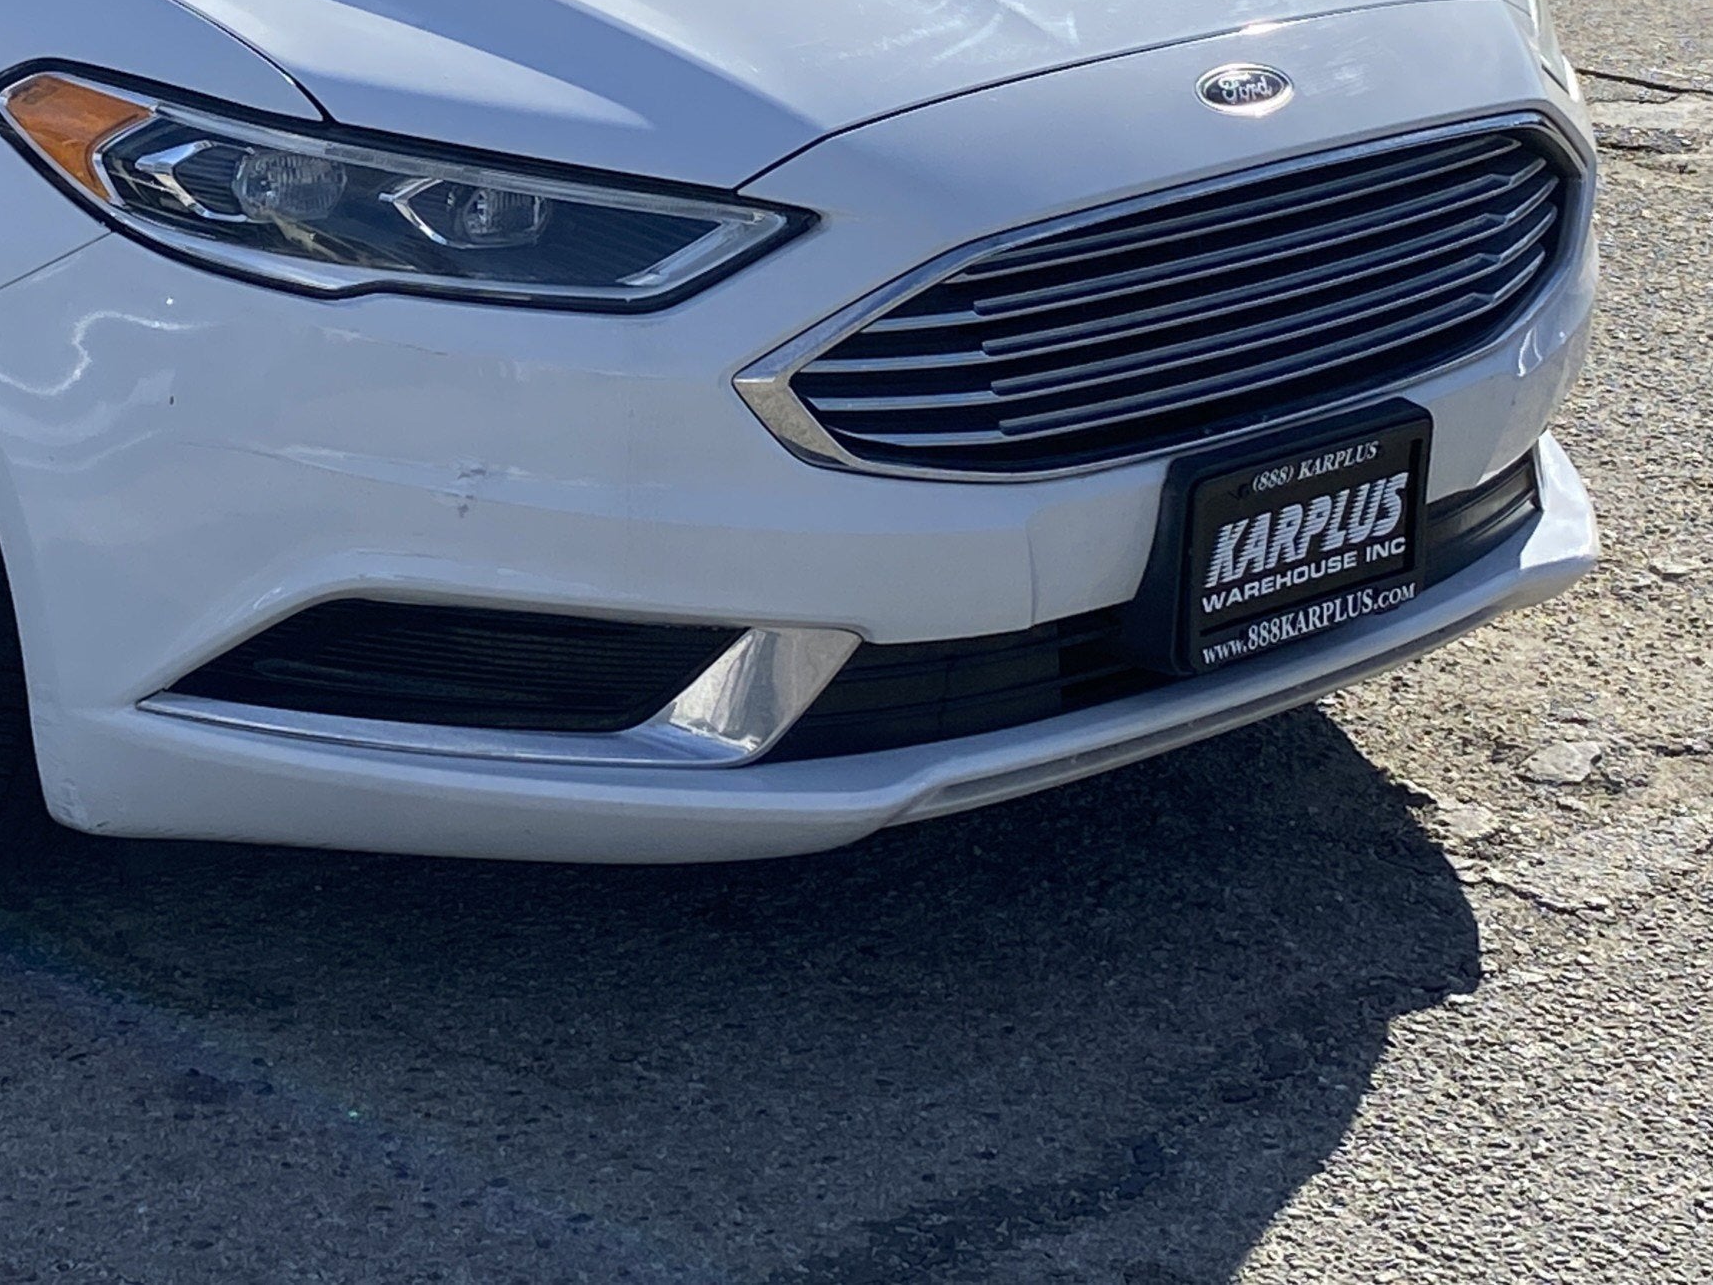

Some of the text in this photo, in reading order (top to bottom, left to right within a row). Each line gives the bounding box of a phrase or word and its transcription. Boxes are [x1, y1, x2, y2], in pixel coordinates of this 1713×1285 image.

[1217, 72, 1273, 105] Ford
[1252, 440, 1379, 493] (888) KARPLUS
[1204, 471, 1409, 589] KARPLUS
[1201, 535, 1406, 614] WAREHOUSE INC
